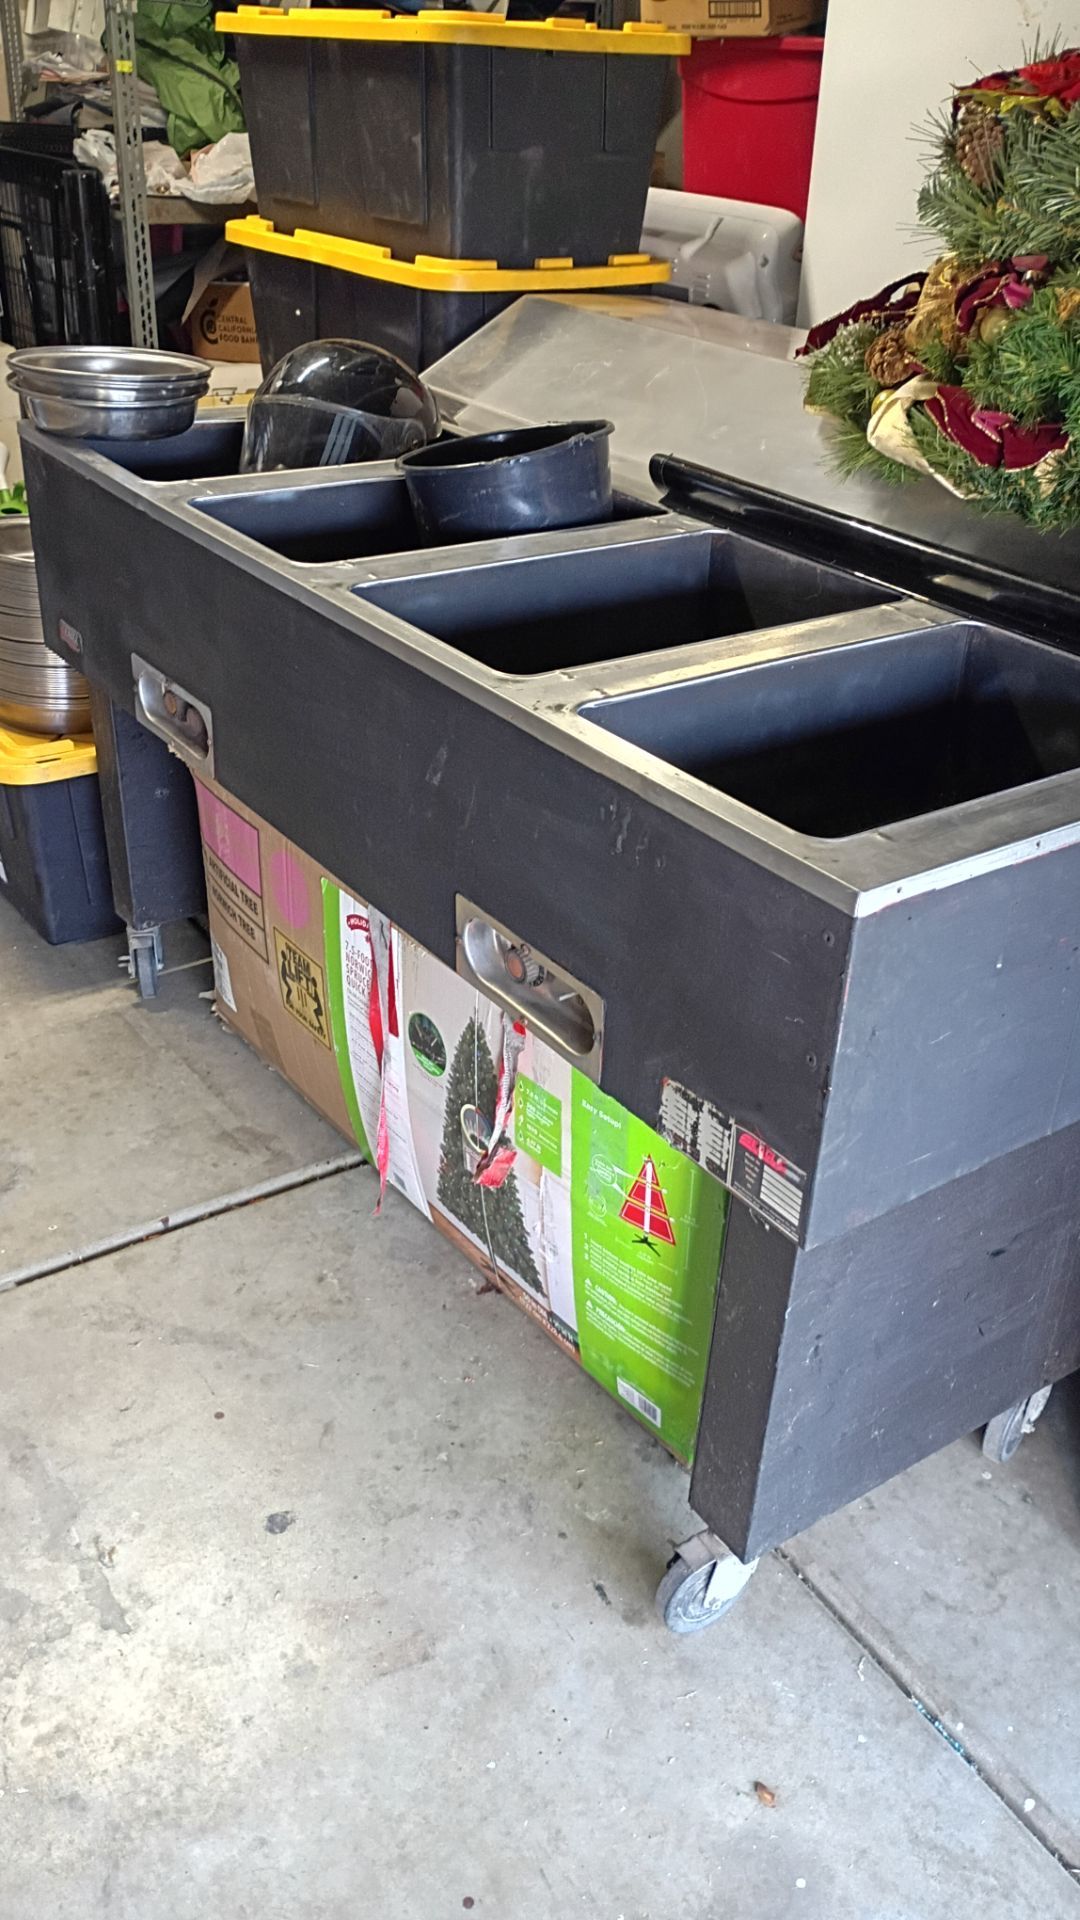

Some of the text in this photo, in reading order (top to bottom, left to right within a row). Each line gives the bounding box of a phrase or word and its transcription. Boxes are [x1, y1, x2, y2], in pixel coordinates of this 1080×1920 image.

[217, 314, 248, 325] CENTRAL
[219, 333, 257, 344] FOOD BAN
[208, 856, 259, 916] ARTIFICIAL TREE
[238, 914, 256, 940] TREE
[285, 942, 312, 978] TEAM
[345, 940, 372, 967] 7.5-FOO
[346, 951, 372, 980] NORWIC
[287, 958, 315, 993] LIFT
